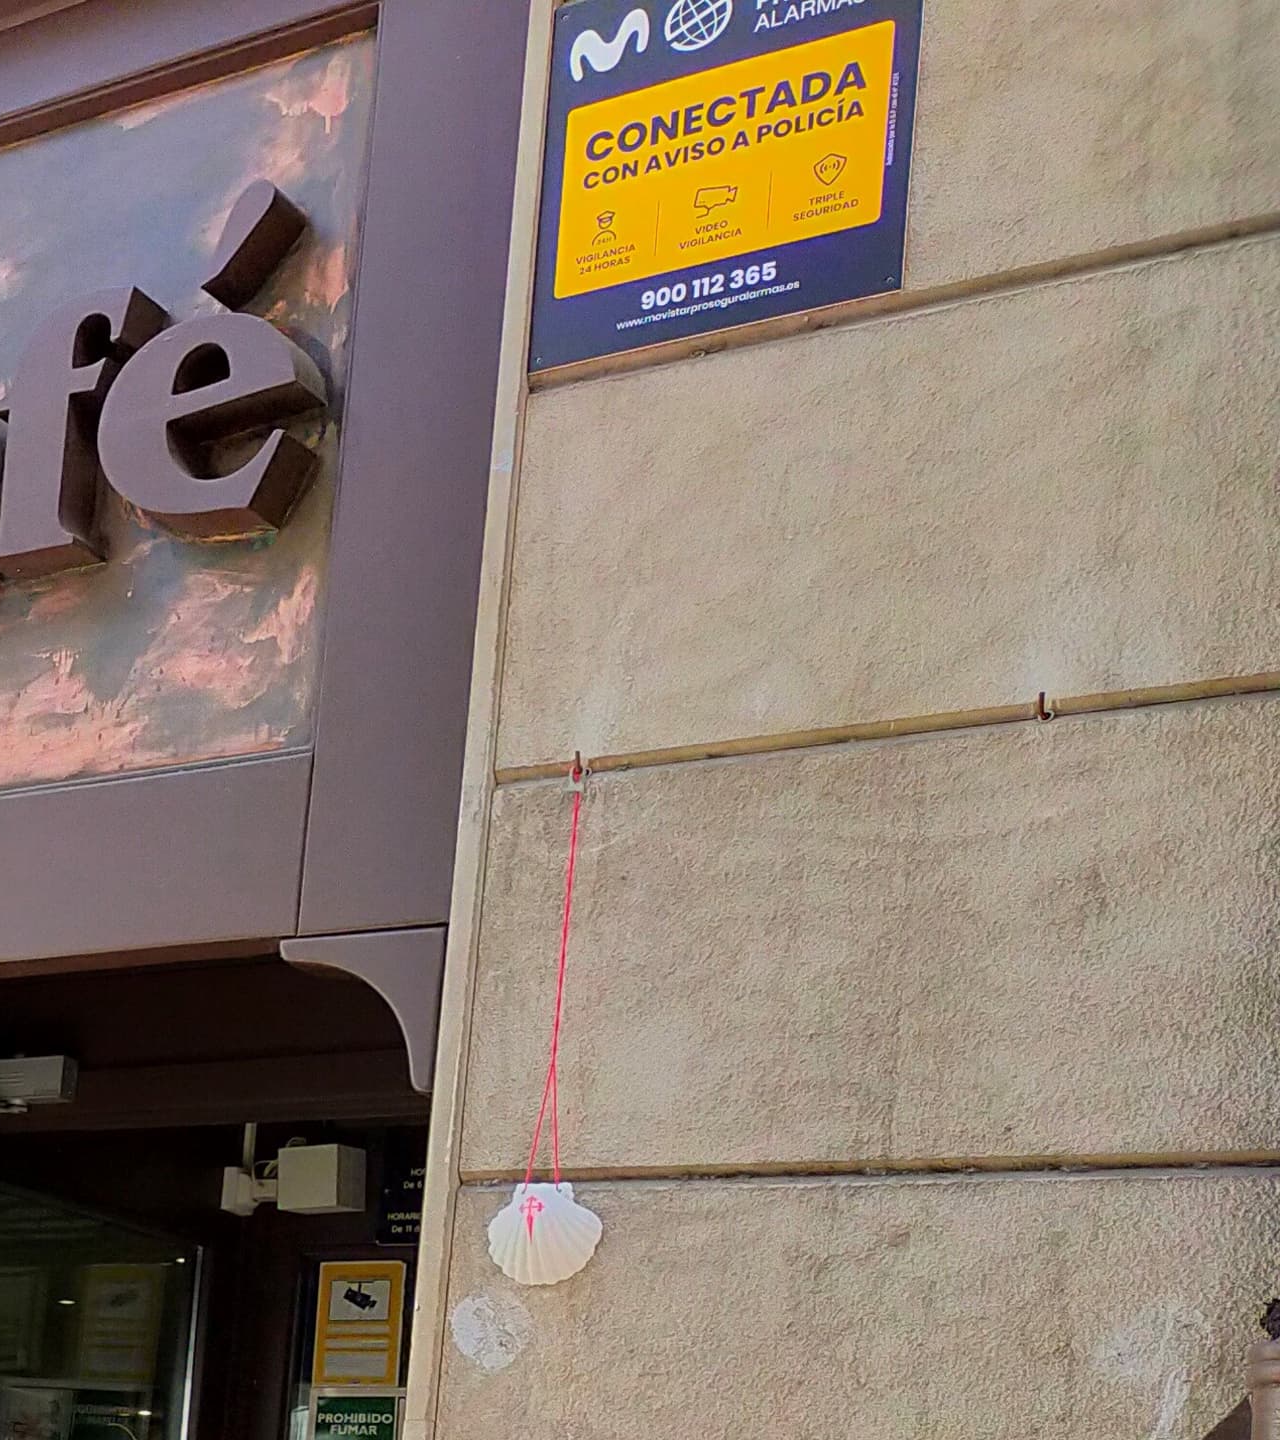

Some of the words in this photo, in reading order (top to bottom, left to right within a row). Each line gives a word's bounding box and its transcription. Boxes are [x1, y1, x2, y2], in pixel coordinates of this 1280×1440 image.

[753, 0, 865, 33] ALARM
[585, 61, 867, 162] CONECTADA
[583, 158, 639, 190] CON
[644, 136, 726, 175] AVISO
[730, 130, 750, 151] A
[756, 98, 865, 143] POLICÍA
[808, 190, 845, 207] TRIPLE
[792, 198, 860, 222] SEGURIDAD
[695, 219, 729, 235] VIDEO
[678, 227, 743, 250] VIGILANCIA
[575, 244, 636, 265] VIGILANCIA
[579, 266, 592, 275] 24
[594, 256, 631, 271] HORAS
[640, 282, 687, 311] 900
[691, 274, 725, 298] 112
[729, 260, 777, 289] 365
[317, 1412, 394, 1424] PROHIBIDO
[329, 1424, 378, 1436] FUMAR
